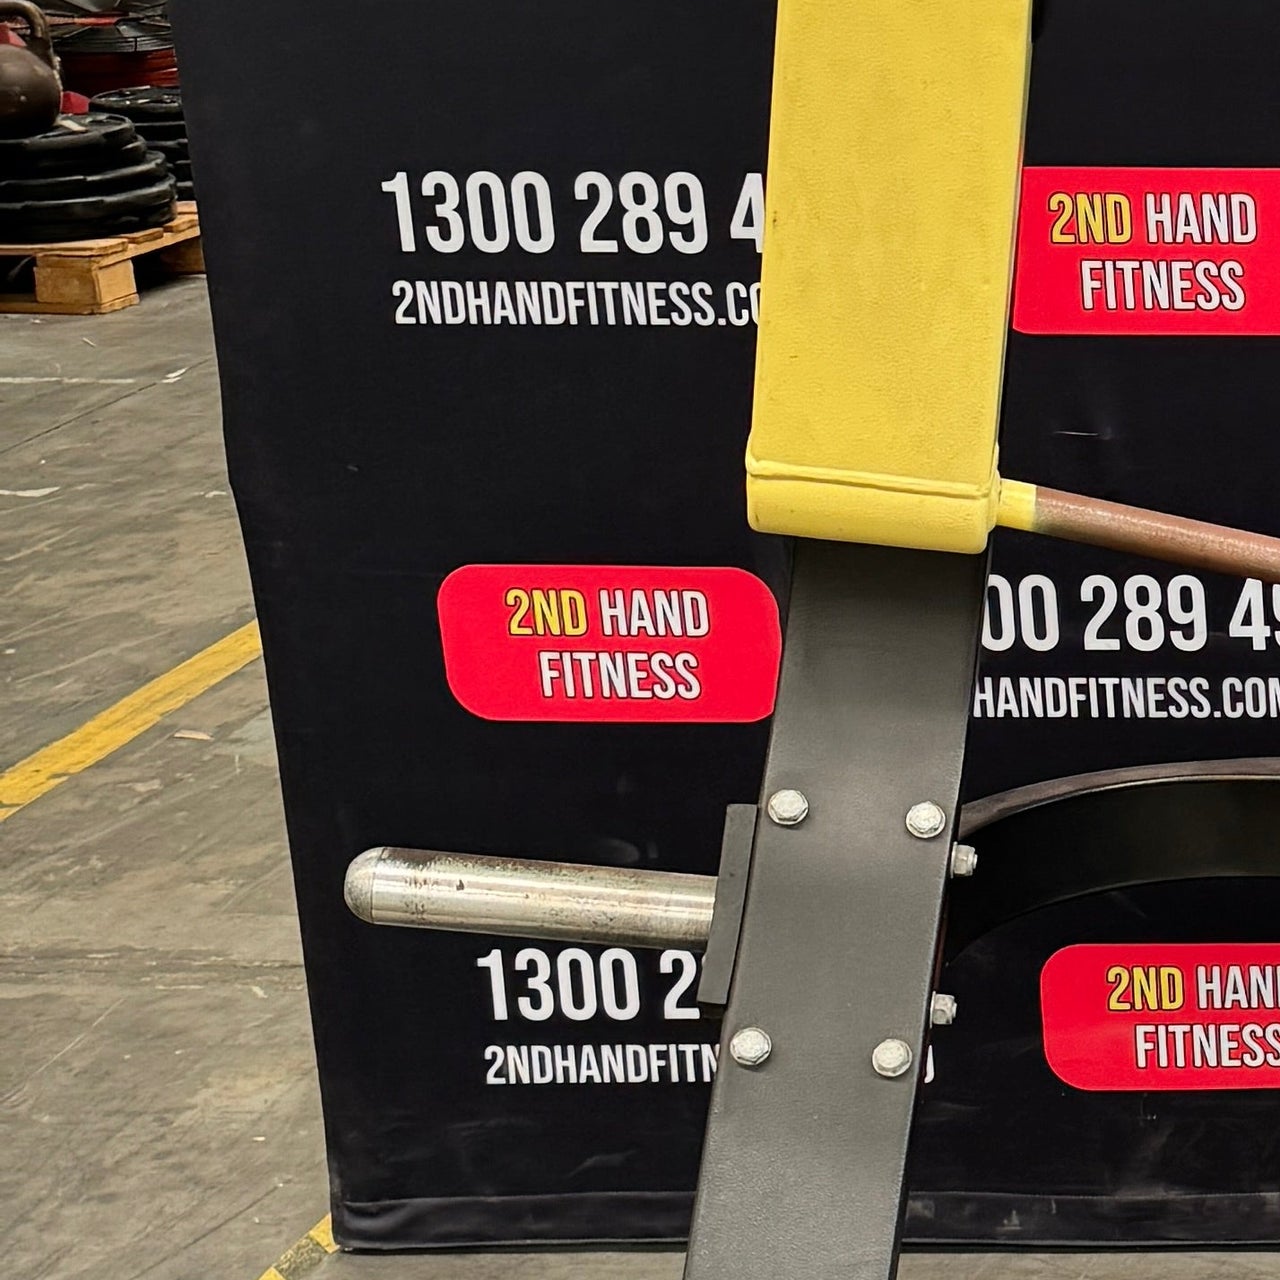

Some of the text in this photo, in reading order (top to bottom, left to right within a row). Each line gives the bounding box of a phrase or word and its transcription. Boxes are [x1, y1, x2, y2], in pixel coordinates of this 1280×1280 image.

[382, 171, 555, 253] 1300
[574, 171, 707, 254] 289
[1050, 194, 1256, 242] 2ND HAND
[1082, 261, 1244, 309] FITNESS
[507, 589, 708, 636] 2ND HAND
[1081, 575, 1207, 651] 289
[540, 652, 700, 698] FITNESS
[477, 948, 640, 1021] 1300
[1108, 967, 1183, 1009] 2ND
